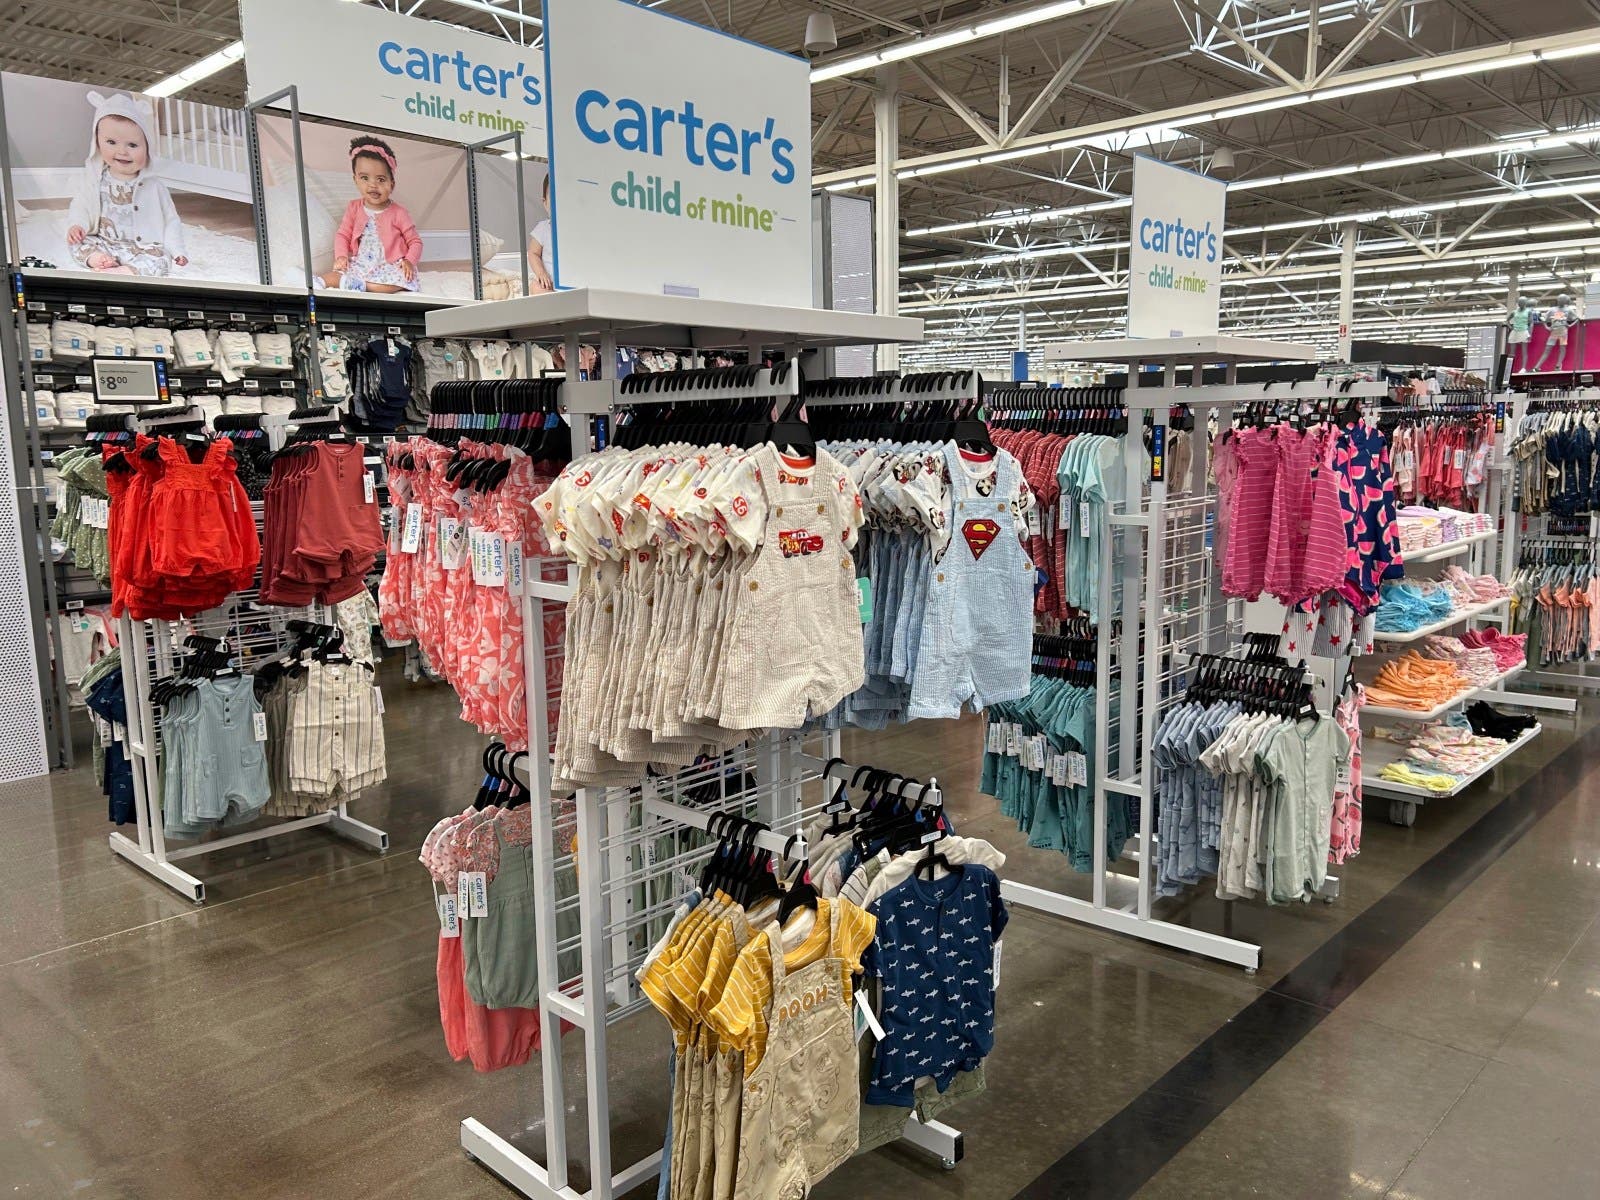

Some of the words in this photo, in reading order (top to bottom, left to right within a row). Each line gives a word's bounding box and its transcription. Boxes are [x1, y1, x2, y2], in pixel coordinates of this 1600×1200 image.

[378, 41, 542, 106] carter's
[404, 91, 456, 122] child
[459, 110, 476, 125] of
[575, 89, 795, 185] carter's
[610, 170, 681, 216] child
[686, 197, 706, 221] of
[1140, 217, 1217, 263] carter's
[1148, 263, 1174, 289] child
[1174, 275, 1183, 290] of
[408, 509, 419, 545] carter's
[493, 538, 504, 577] carter's
[513, 547, 522, 587] carter's
[476, 877, 484, 910] carter's
[448, 899, 457, 931] carter's
[778, 983, 829, 1026] POOH
